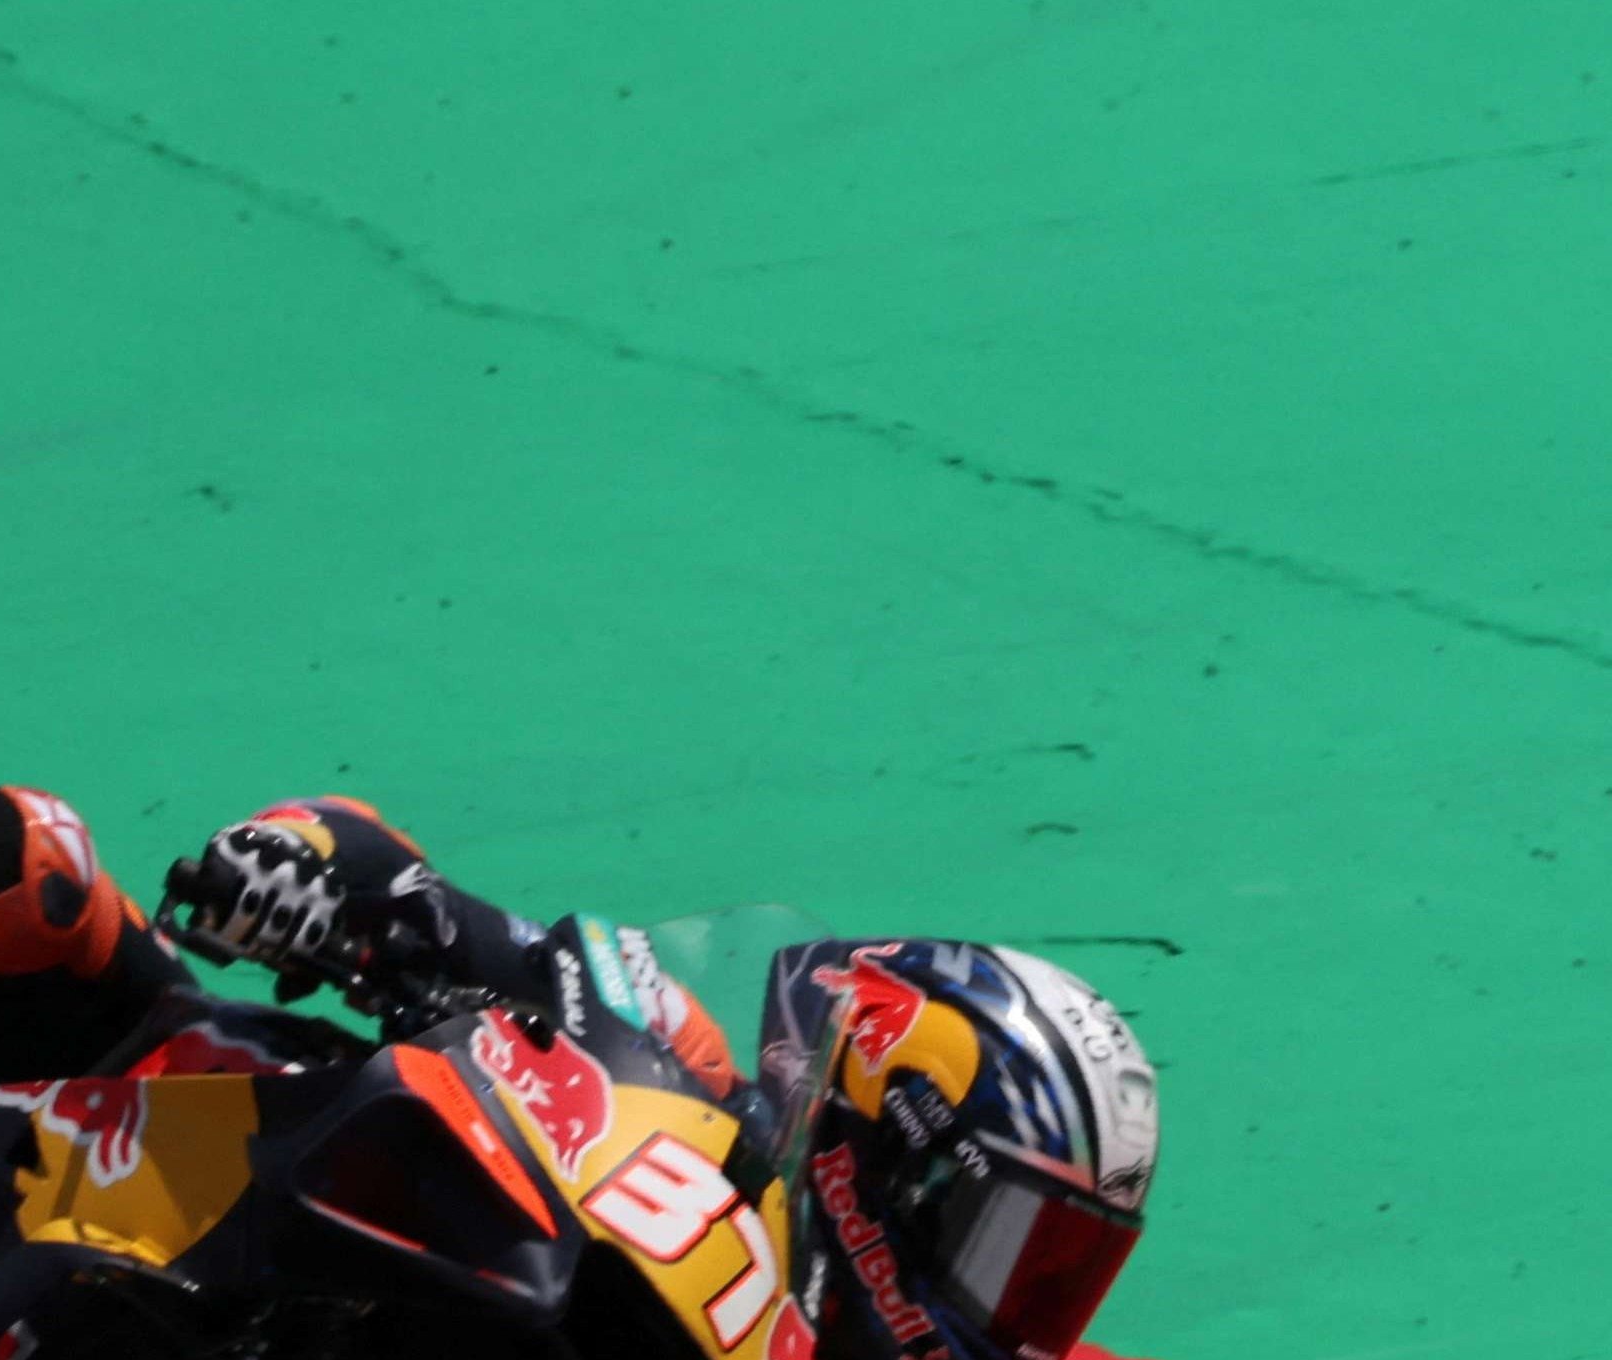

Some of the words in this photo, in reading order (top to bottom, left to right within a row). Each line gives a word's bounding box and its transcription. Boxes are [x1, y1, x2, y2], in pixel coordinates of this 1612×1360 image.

[579, 1130, 780, 1353] 37
[812, 1141, 885, 1251] Red
[851, 1243, 936, 1344] Bull
